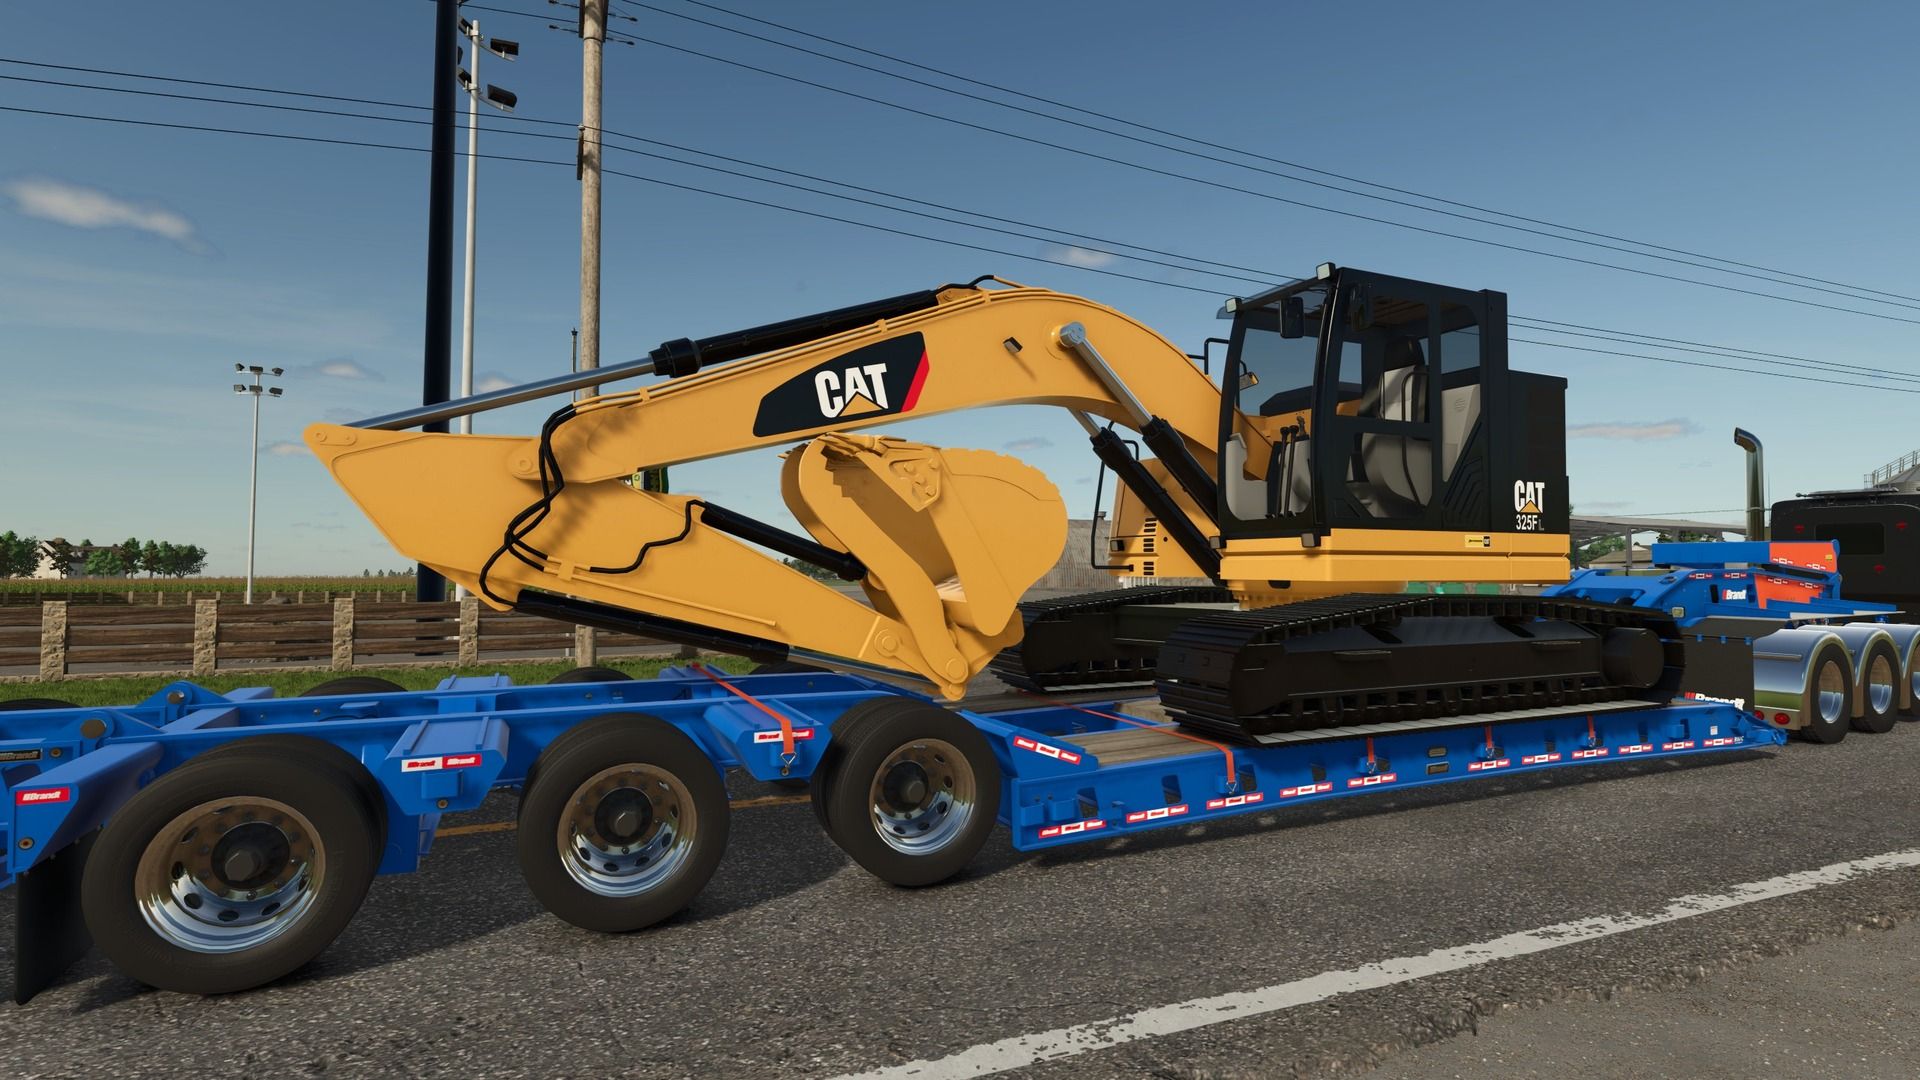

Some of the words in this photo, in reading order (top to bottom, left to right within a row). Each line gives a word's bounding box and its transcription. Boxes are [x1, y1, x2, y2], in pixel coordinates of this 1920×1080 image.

[814, 363, 889, 418] CAT
[1514, 479, 1545, 513] CAT
[1516, 514, 1538, 531] 325F
